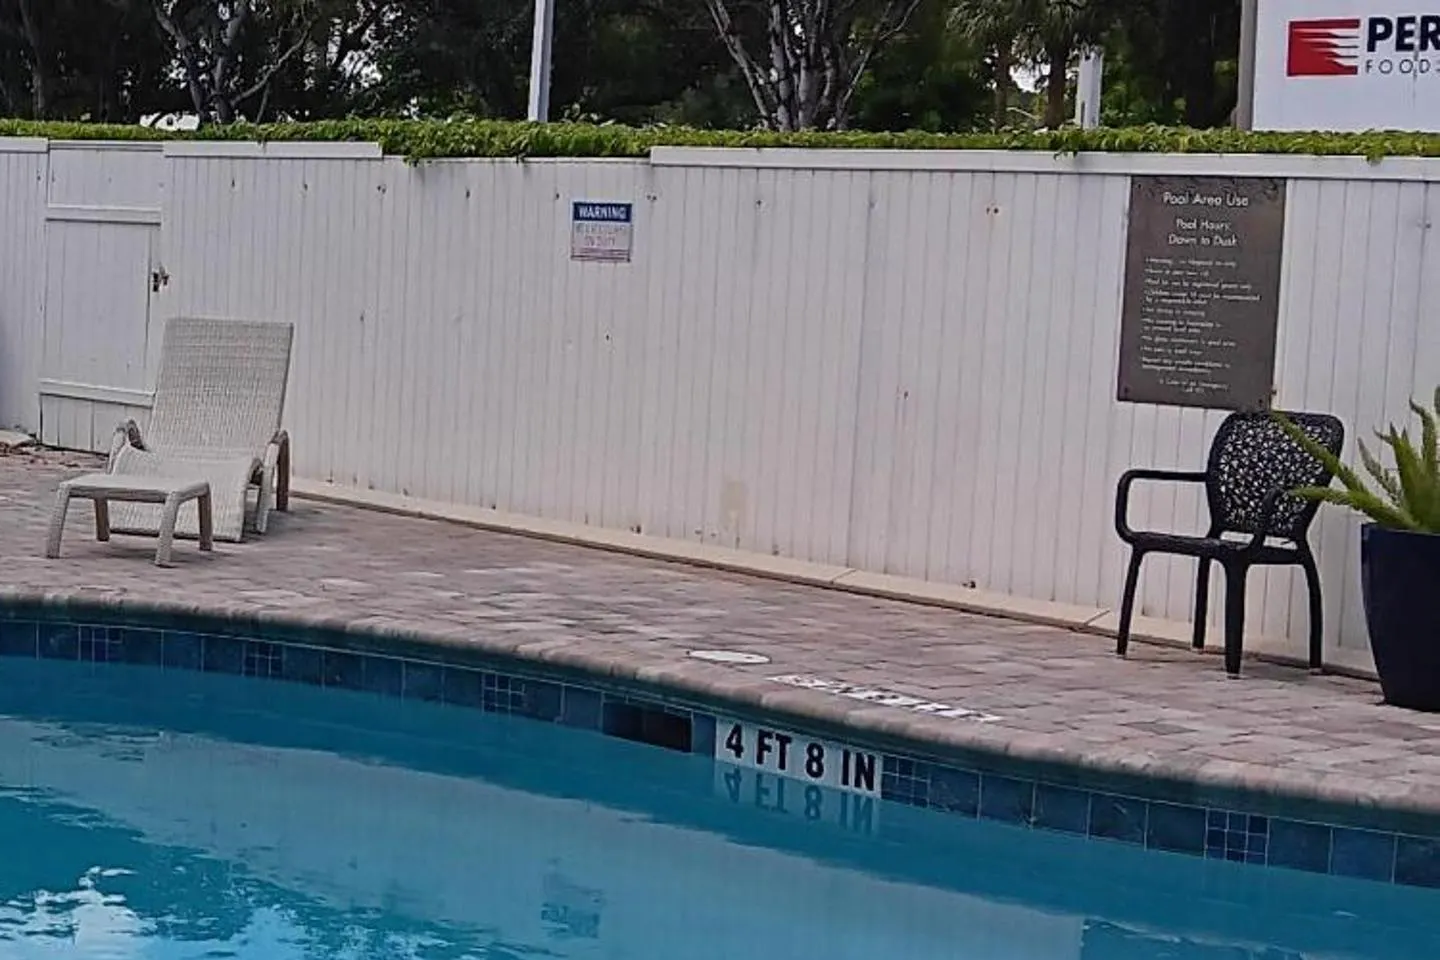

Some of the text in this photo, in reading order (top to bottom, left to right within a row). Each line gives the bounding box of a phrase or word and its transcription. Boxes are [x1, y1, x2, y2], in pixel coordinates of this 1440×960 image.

[1366, 15, 1440, 52] PER
[1163, 191, 1249, 207] Pool Area Use
[579, 206, 627, 220] WARNING
[1176, 218, 1197, 230] Pool
[1213, 235, 1238, 247] Dusk
[725, 724, 875, 791] 4 FT 8 IN
